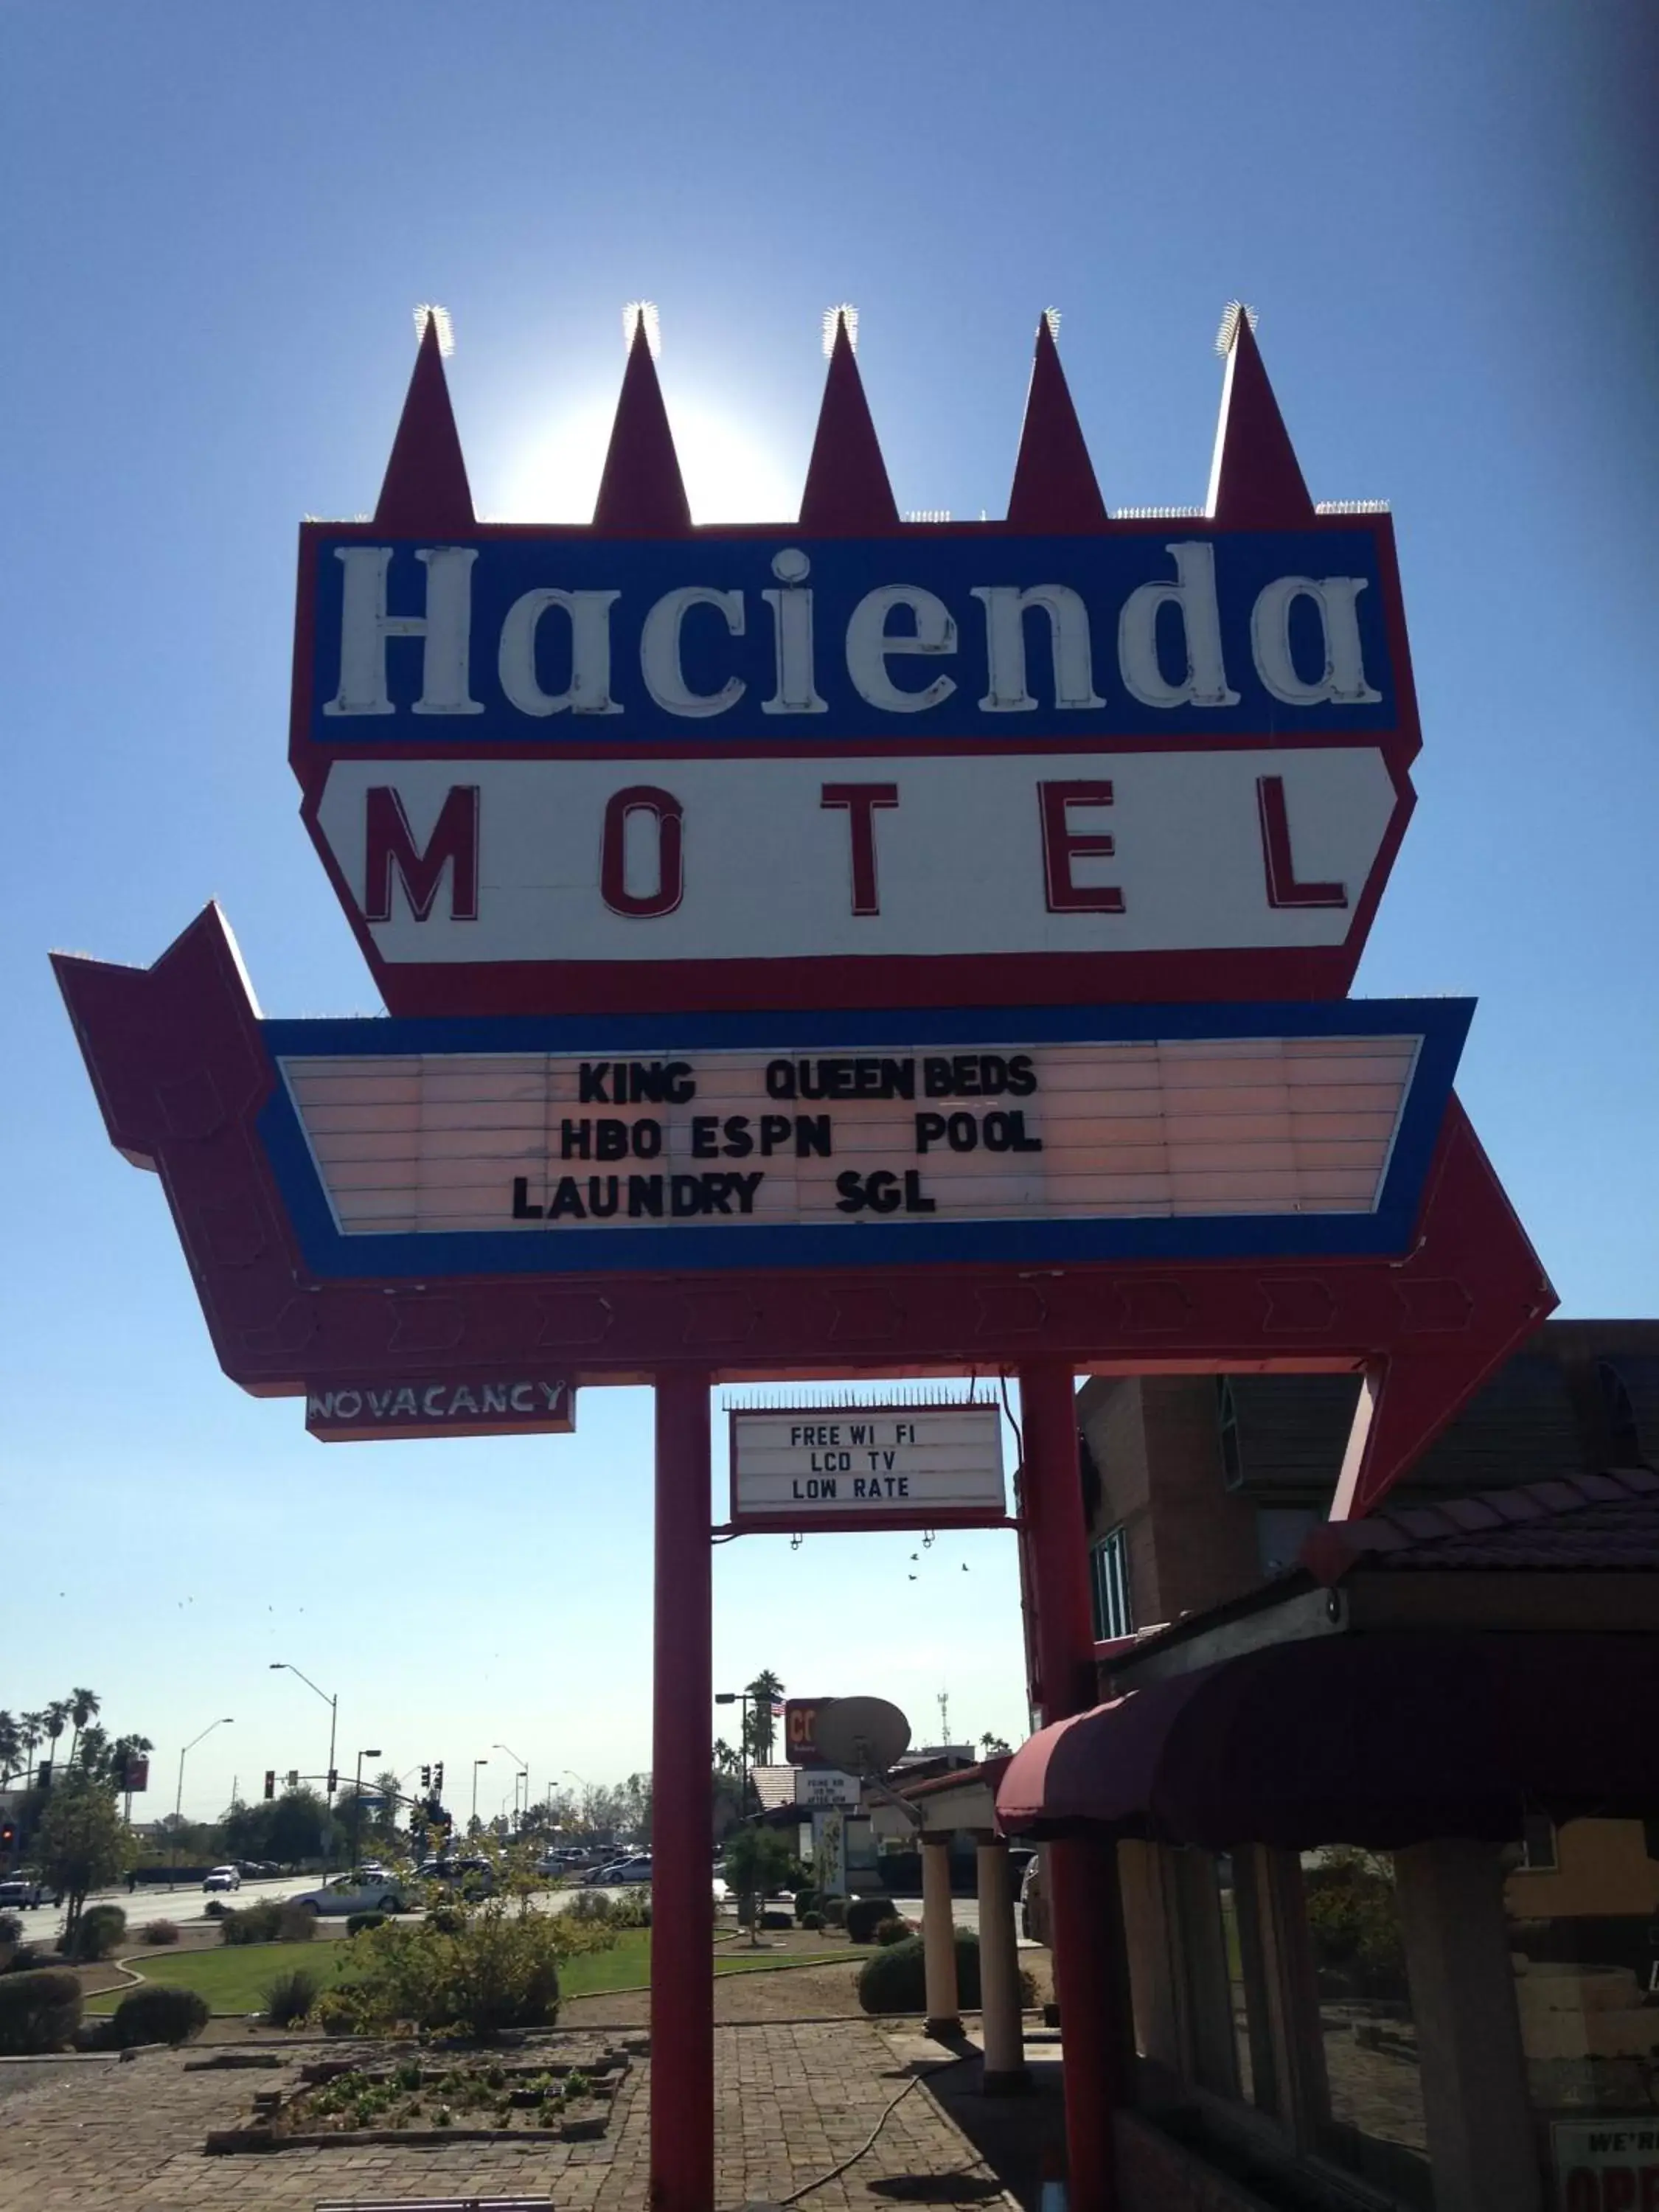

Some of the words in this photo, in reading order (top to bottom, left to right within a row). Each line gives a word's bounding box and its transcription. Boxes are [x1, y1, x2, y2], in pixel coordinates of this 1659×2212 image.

[322, 541, 1383, 718] Hacienda
[362, 775, 1349, 922] MOTEL
[578, 1061, 696, 1105] KING
[765, 1057, 915, 1102] QUEEN
[923, 1054, 1038, 1098] BEDS
[560, 1118, 662, 1161] HBO
[691, 1114, 832, 1158] ESPN
[915, 1110, 1043, 1155] POOL
[512, 1172, 765, 1220] LAUNDRY
[835, 1169, 936, 1214] SGL
[790, 1425, 840, 1447] FREE
[849, 1425, 874, 1445] WI
[896, 1424, 916, 1444] FI
[811, 1452, 851, 1472] LCD
[868, 1451, 896, 1471] TV
[793, 1479, 837, 1499] LOW
[854, 1477, 909, 1498] RATE
[1590, 2132, 1659, 2152] WE'R
